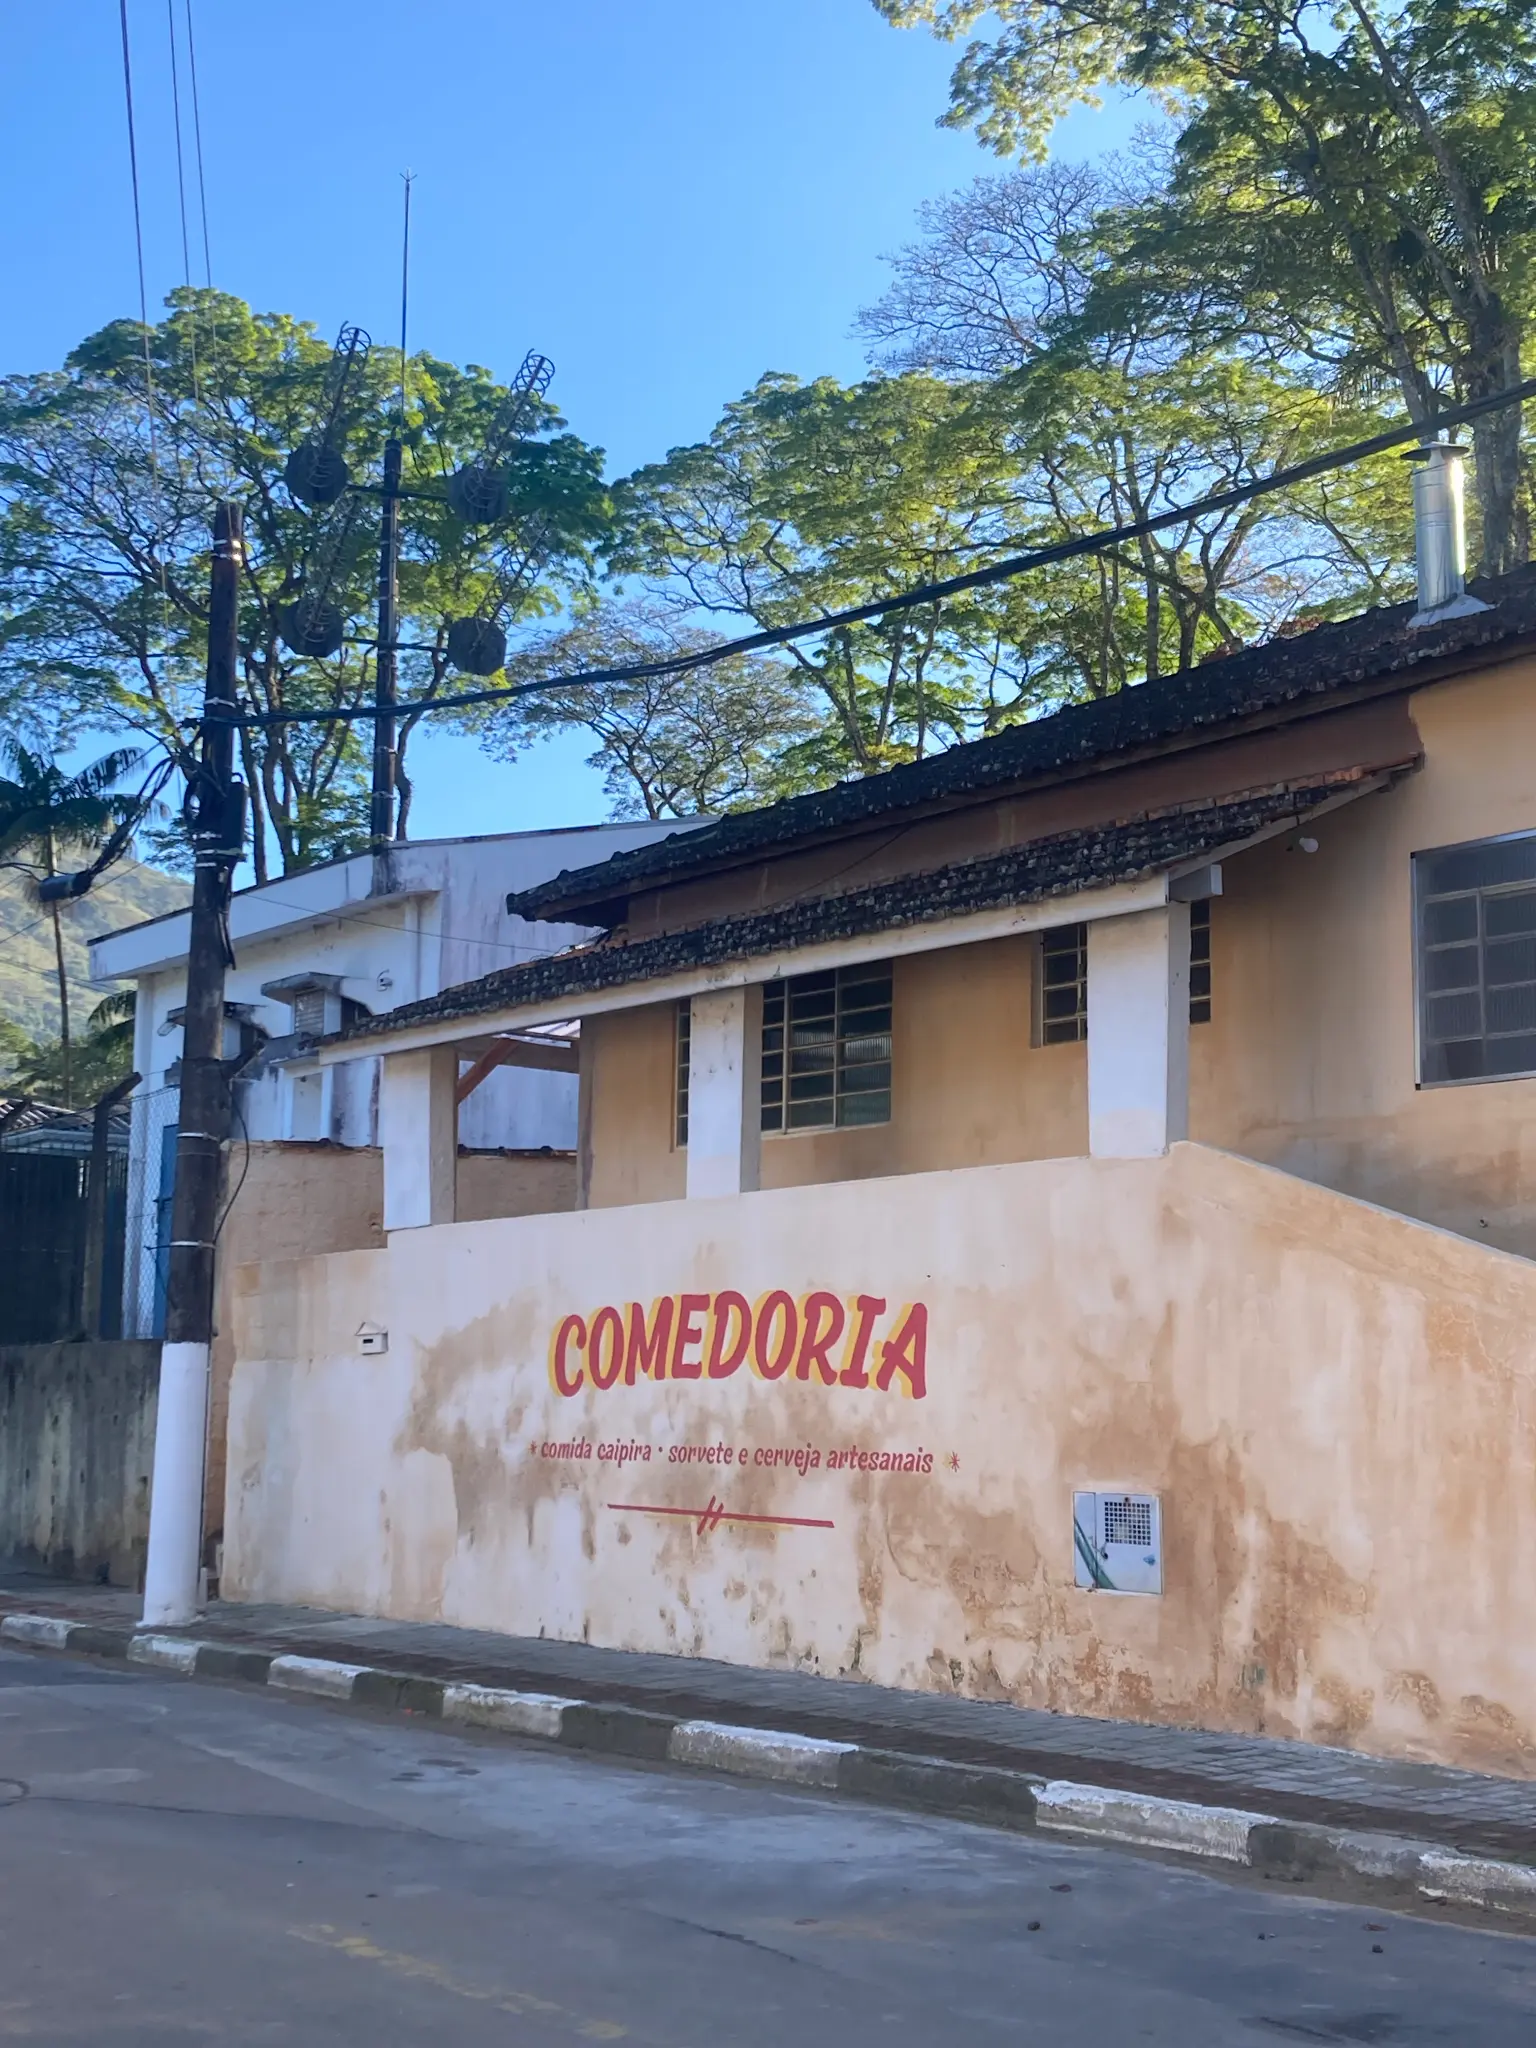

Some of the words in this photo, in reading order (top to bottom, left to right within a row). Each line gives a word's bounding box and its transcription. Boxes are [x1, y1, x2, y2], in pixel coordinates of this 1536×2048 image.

[549, 1290, 928, 1399] COMEDORIA
[540, 1436, 592, 1461] comida
[597, 1438, 651, 1468] caipira
[667, 1441, 733, 1465] sorvete
[738, 1448, 749, 1465] e
[754, 1441, 821, 1476] cerveja
[826, 1445, 934, 1474] artesanais
